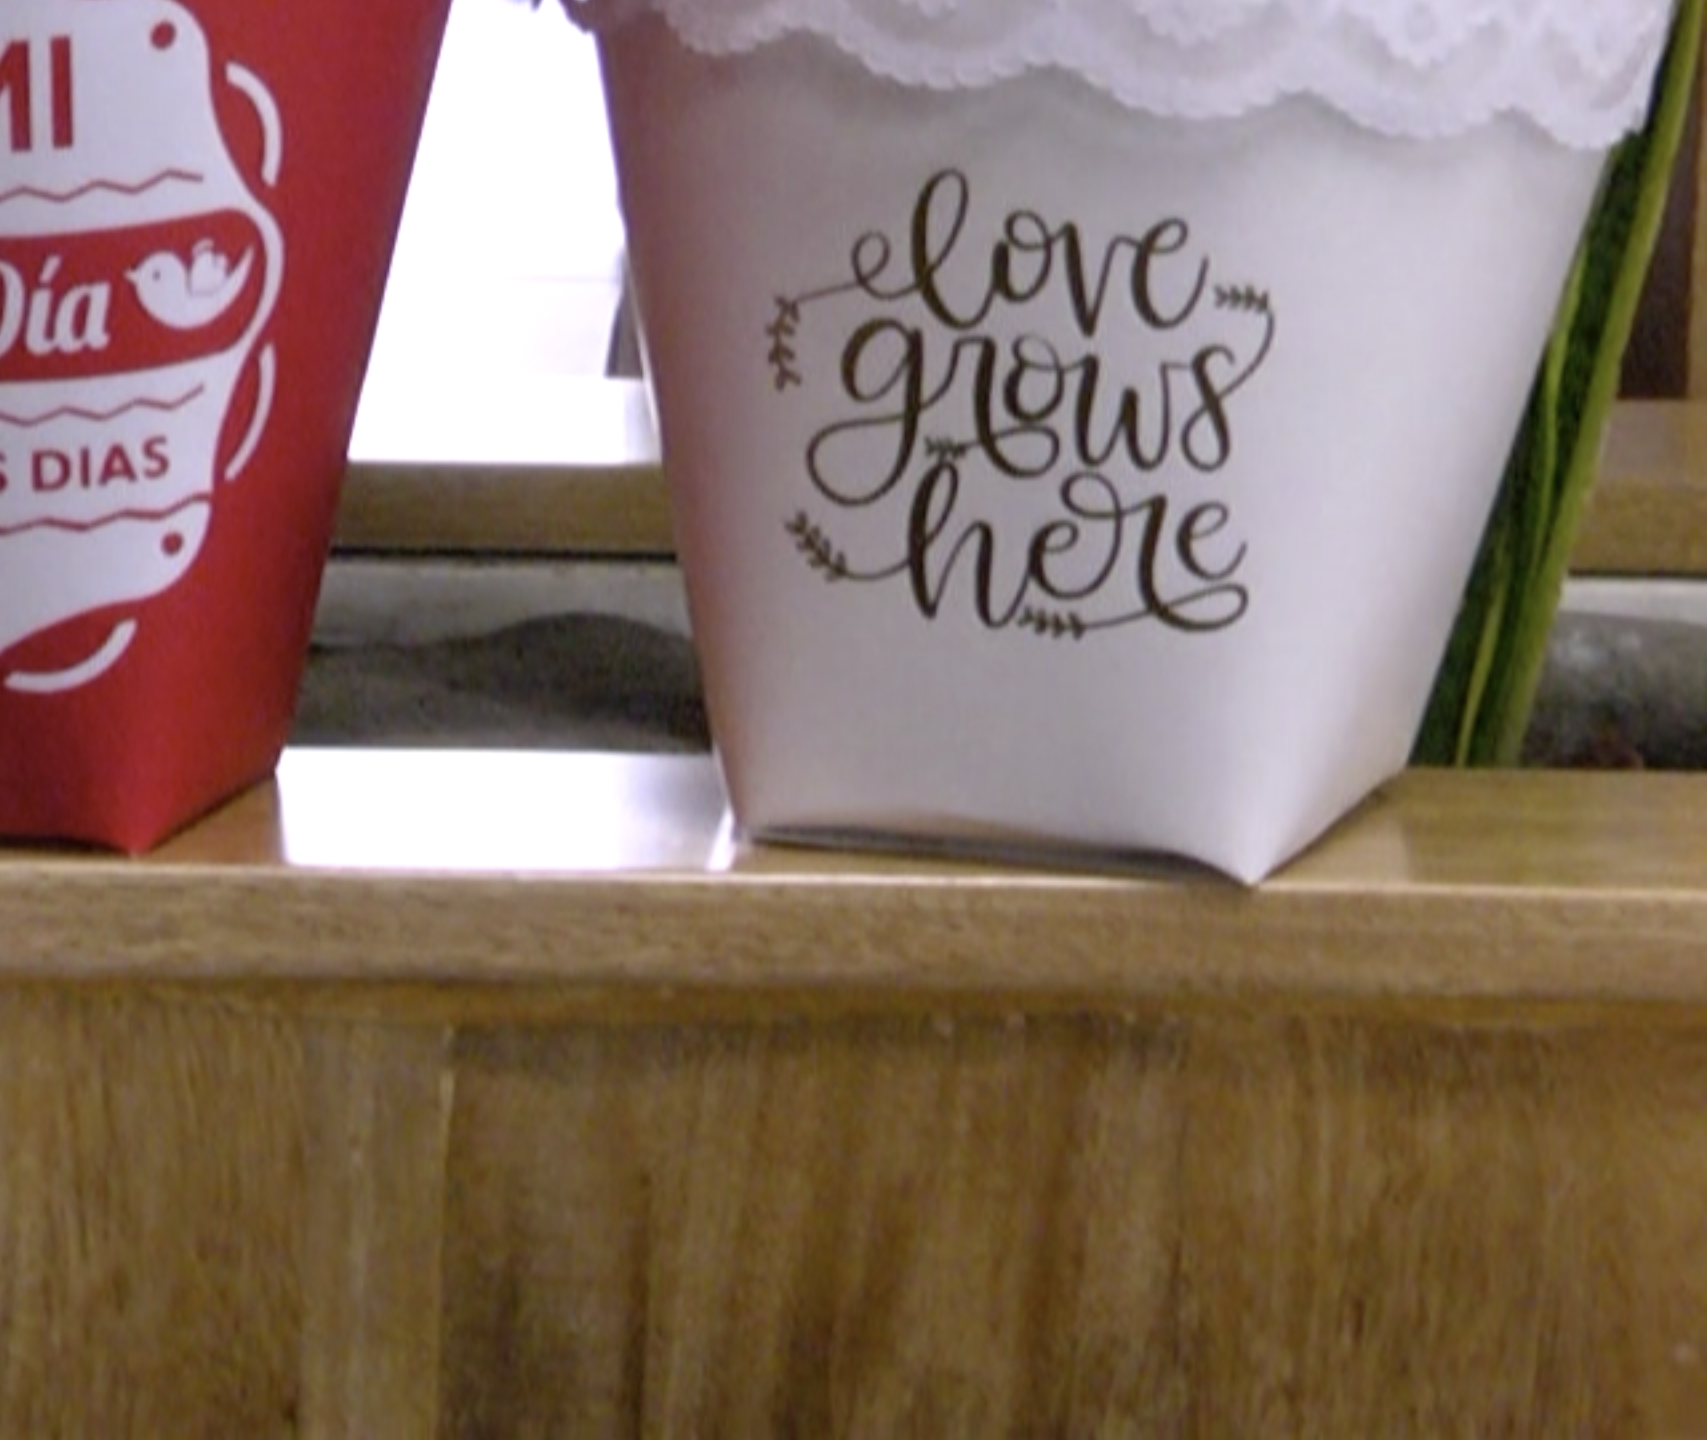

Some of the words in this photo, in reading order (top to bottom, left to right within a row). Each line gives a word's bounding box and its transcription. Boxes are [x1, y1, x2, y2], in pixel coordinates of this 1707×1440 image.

[852, 167, 1211, 338] love
[31, 435, 171, 492] DIAS
[806, 317, 1247, 506] grows
[906, 460, 1250, 632] here
